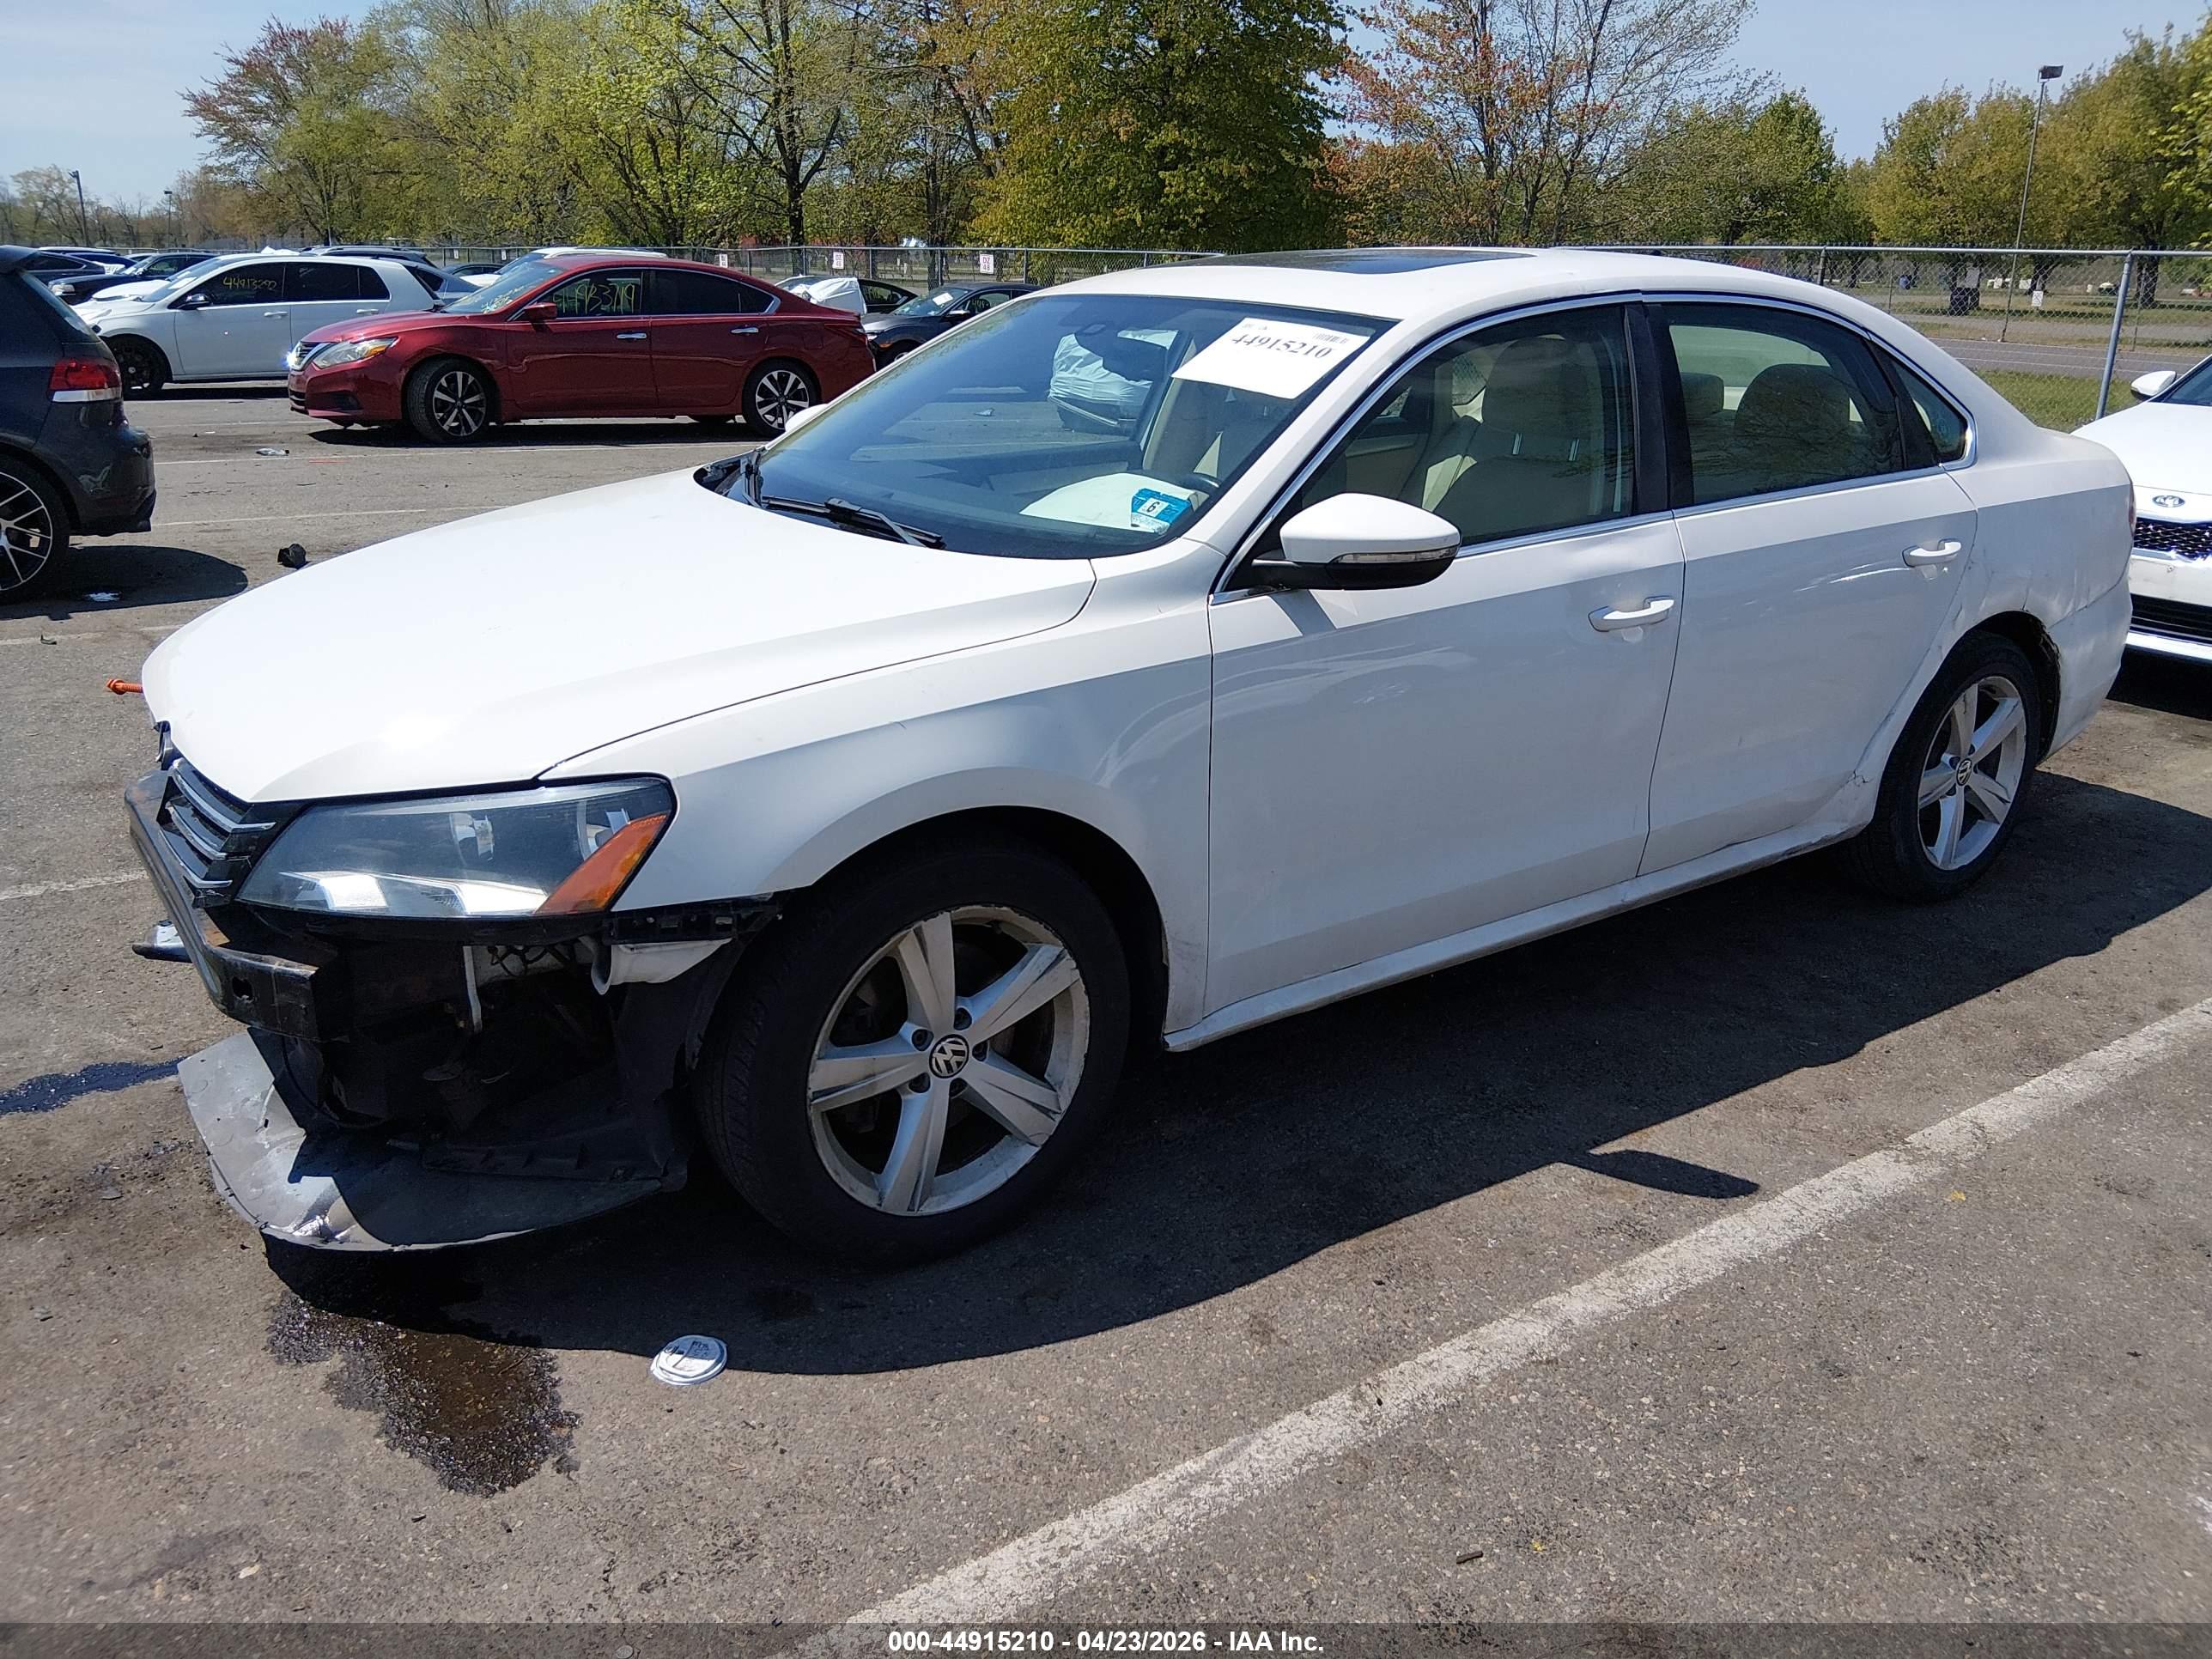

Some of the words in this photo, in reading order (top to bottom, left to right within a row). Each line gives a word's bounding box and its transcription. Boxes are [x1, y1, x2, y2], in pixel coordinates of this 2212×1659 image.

[982, 256, 991, 264] DZ
[1231, 333, 1334, 359] 44915210
[1146, 501, 1161, 514] 6
[931, 1036, 968, 1076] VW
